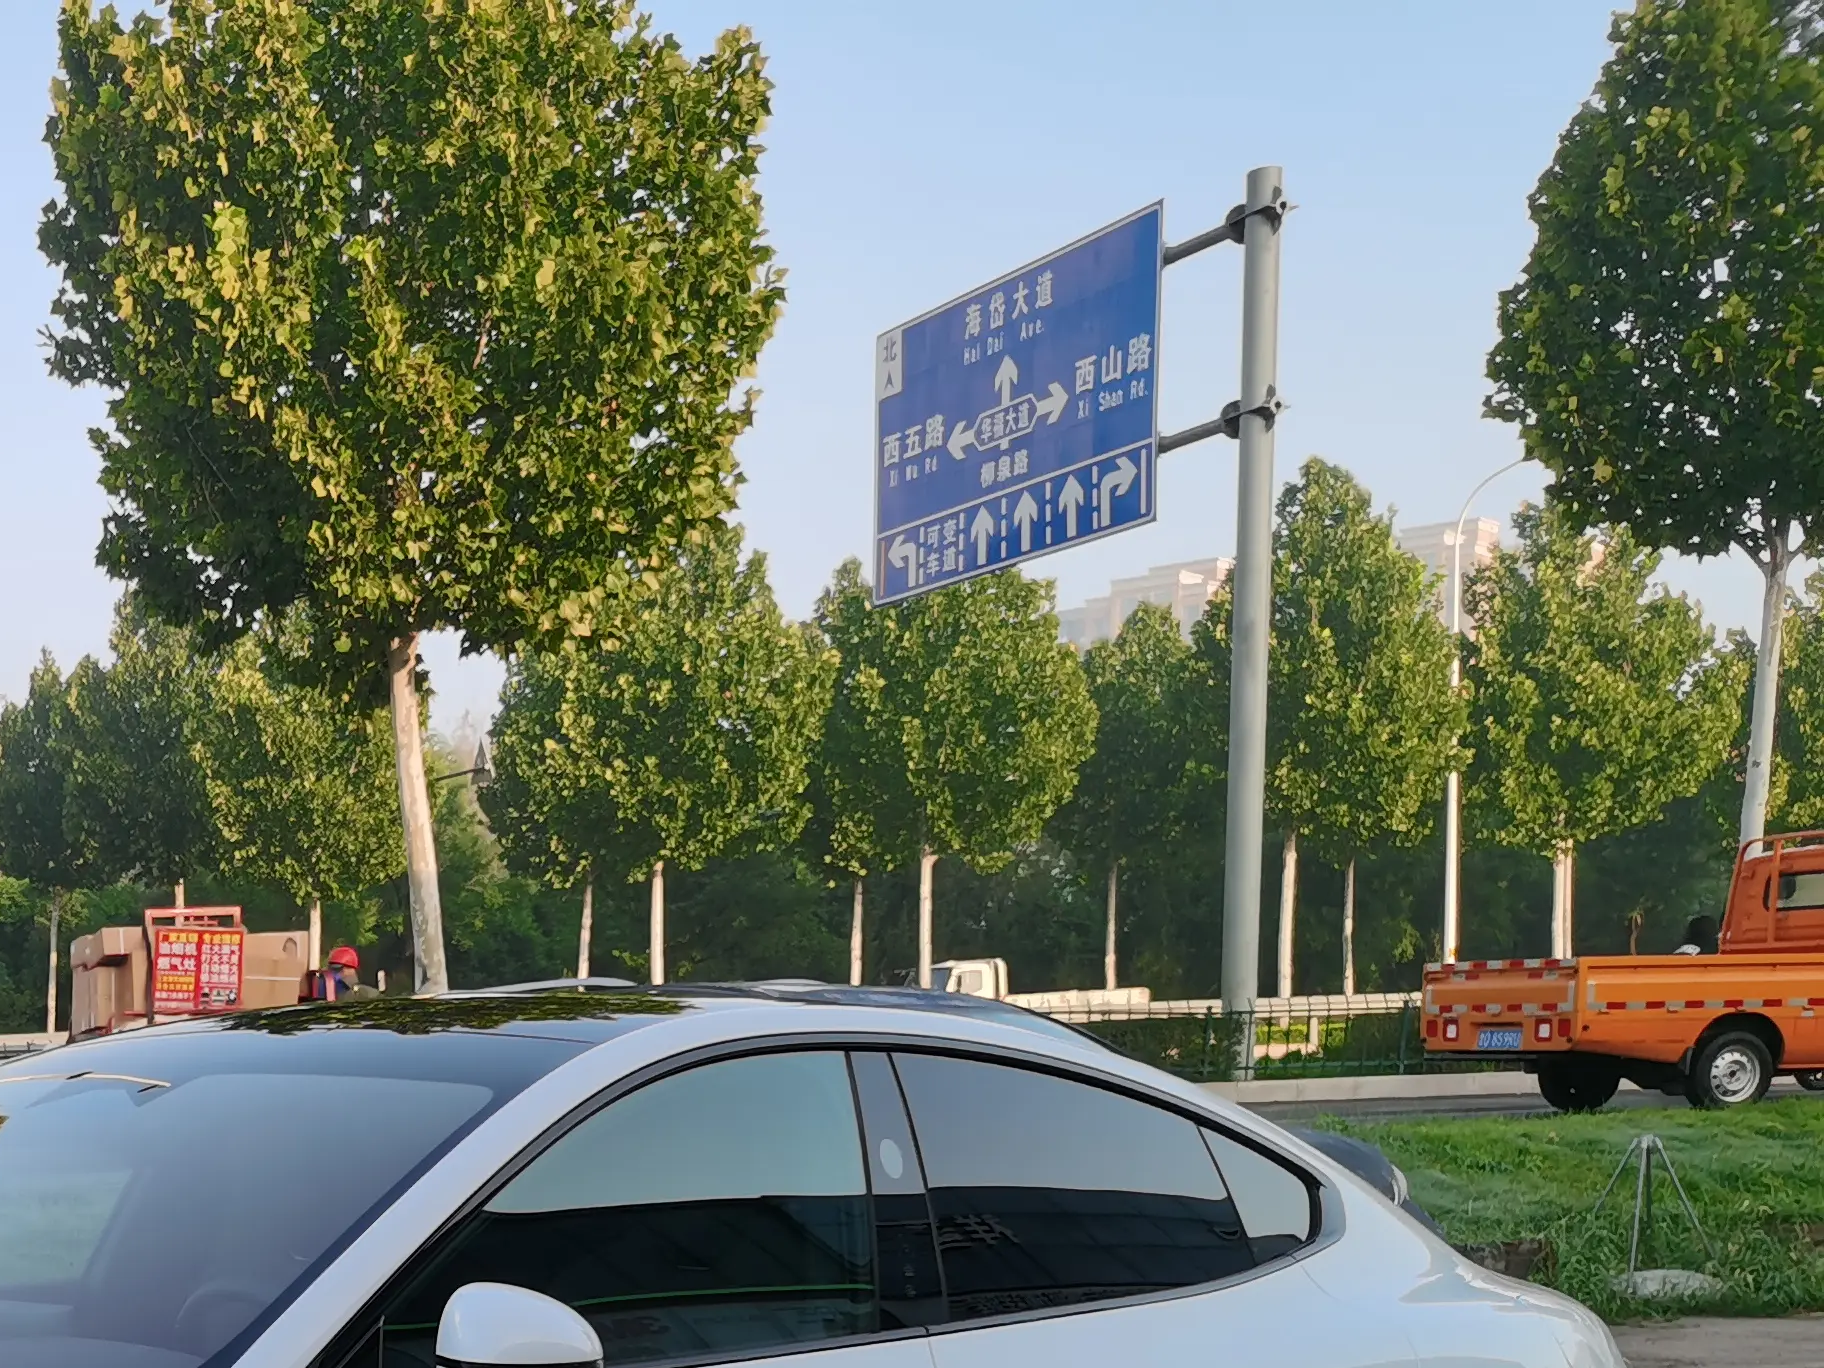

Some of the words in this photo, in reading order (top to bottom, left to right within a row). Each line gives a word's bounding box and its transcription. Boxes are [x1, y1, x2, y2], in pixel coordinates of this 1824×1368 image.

[964, 269, 1053, 340] 海岱大道
[883, 338, 897, 361] 北
[1075, 332, 1152, 395] 西山路
[1077, 397, 1089, 419] Xi
[1098, 389, 1123, 411] Shan
[882, 414, 944, 467] 西五路
[926, 518, 957, 549] 可变
[926, 545, 957, 577] 车道
